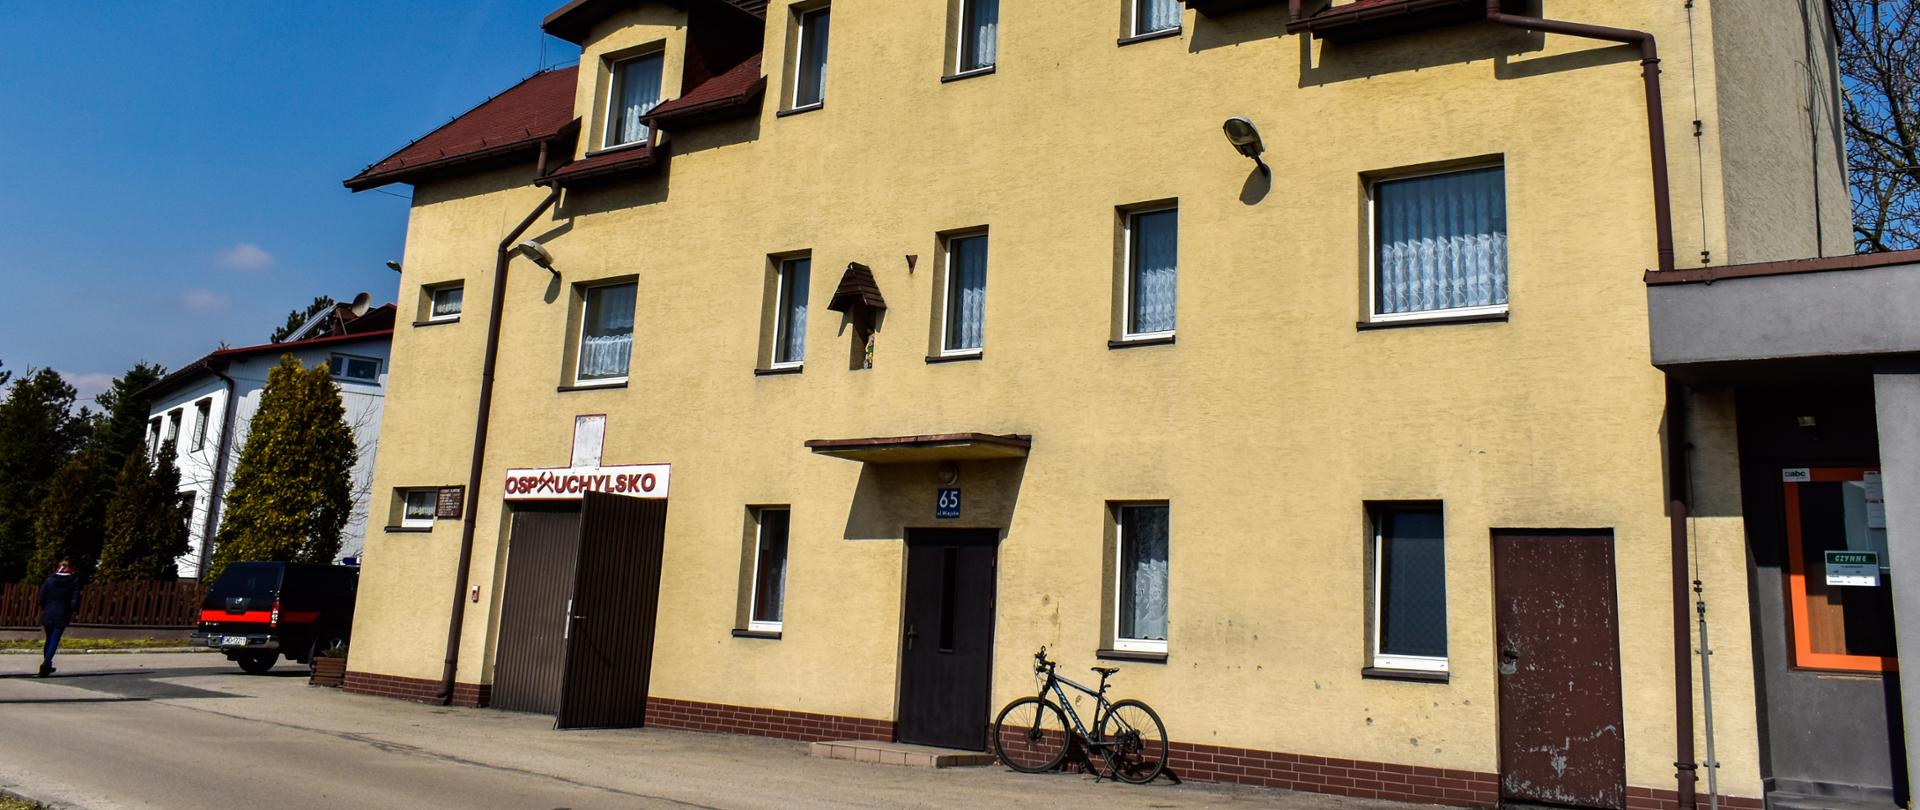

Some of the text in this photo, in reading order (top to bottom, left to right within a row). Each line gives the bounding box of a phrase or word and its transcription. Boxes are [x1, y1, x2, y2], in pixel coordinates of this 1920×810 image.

[505, 473, 656, 494] OSP UCHYLSKO
[939, 490, 958, 508] 65
[1834, 554, 1867, 563] CZYNNE
